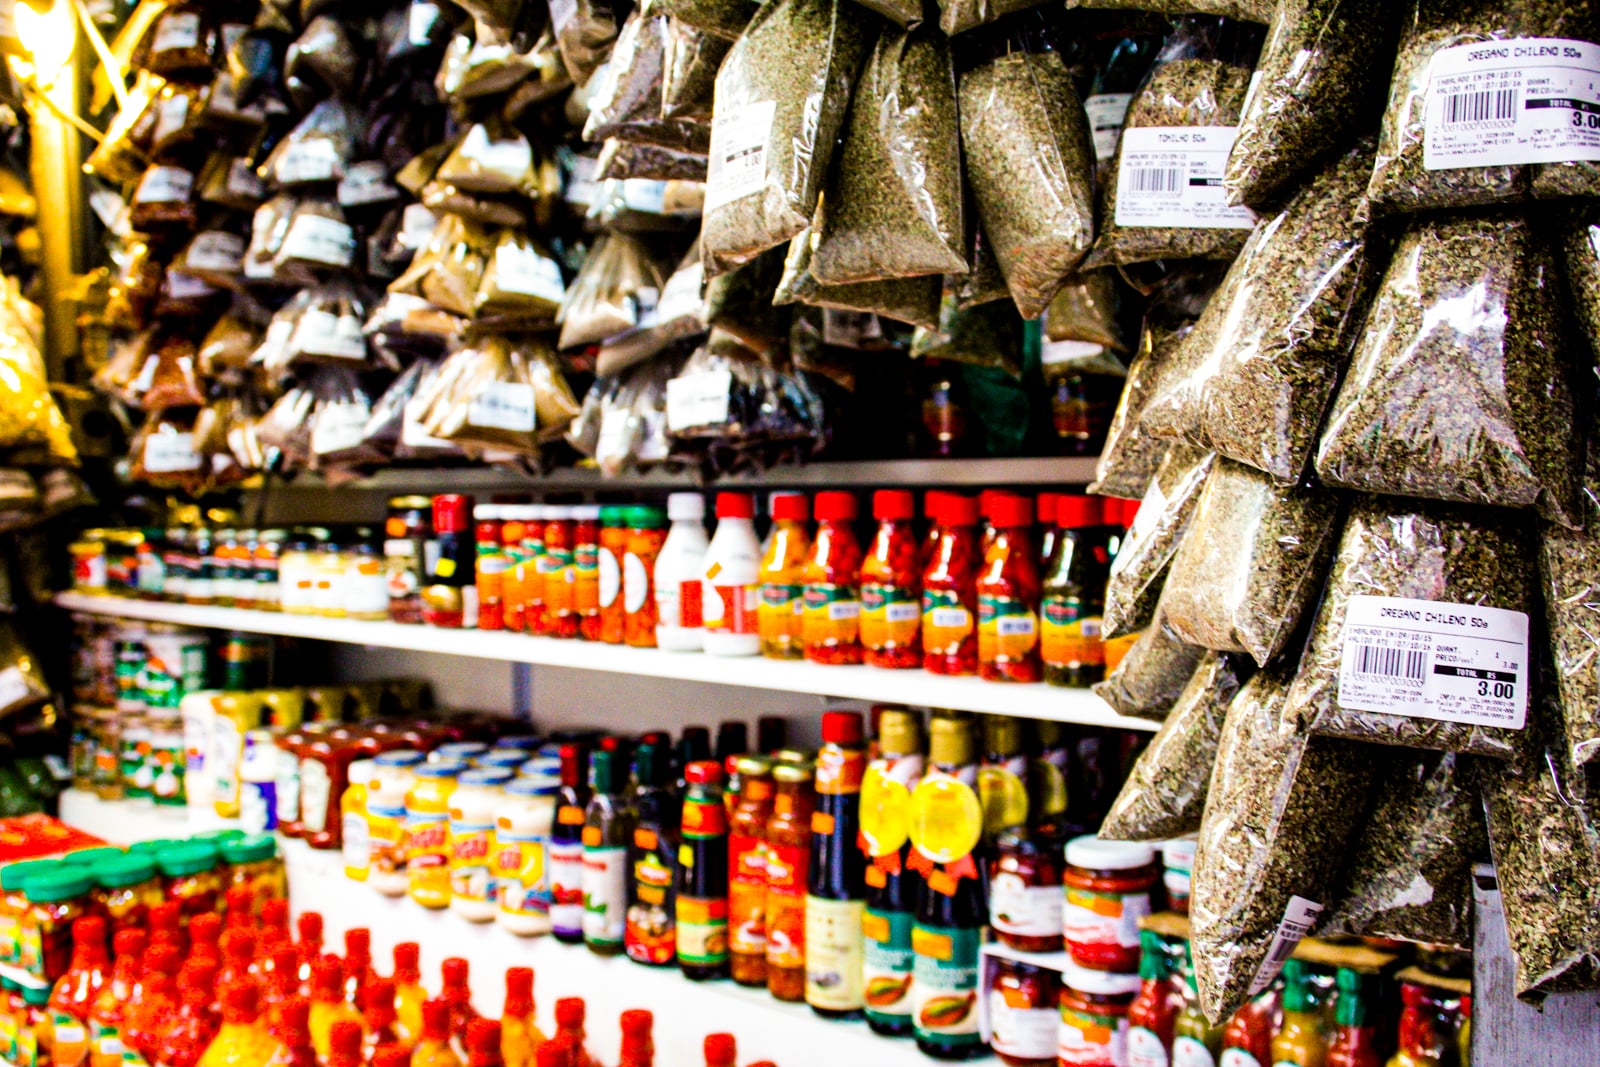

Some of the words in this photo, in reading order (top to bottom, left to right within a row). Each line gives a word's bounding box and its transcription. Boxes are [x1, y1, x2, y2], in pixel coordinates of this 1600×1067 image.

[1467, 47, 1509, 62] OREGANO
[1514, 46, 1559, 57] CHILENO
[1549, 100, 1572, 108] TOTAL
[1572, 111, 1600, 128] 3.0
[1158, 134, 1188, 143] TOMILHO
[1380, 607, 1421, 621] OREGANO
[1425, 612, 1466, 626] CHILENO
[1349, 627, 1382, 637] EMBALADO
[1376, 638, 1388, 646] ATE
[1456, 667, 1478, 678] TOTAL
[1477, 680, 1514, 700] 3.00
